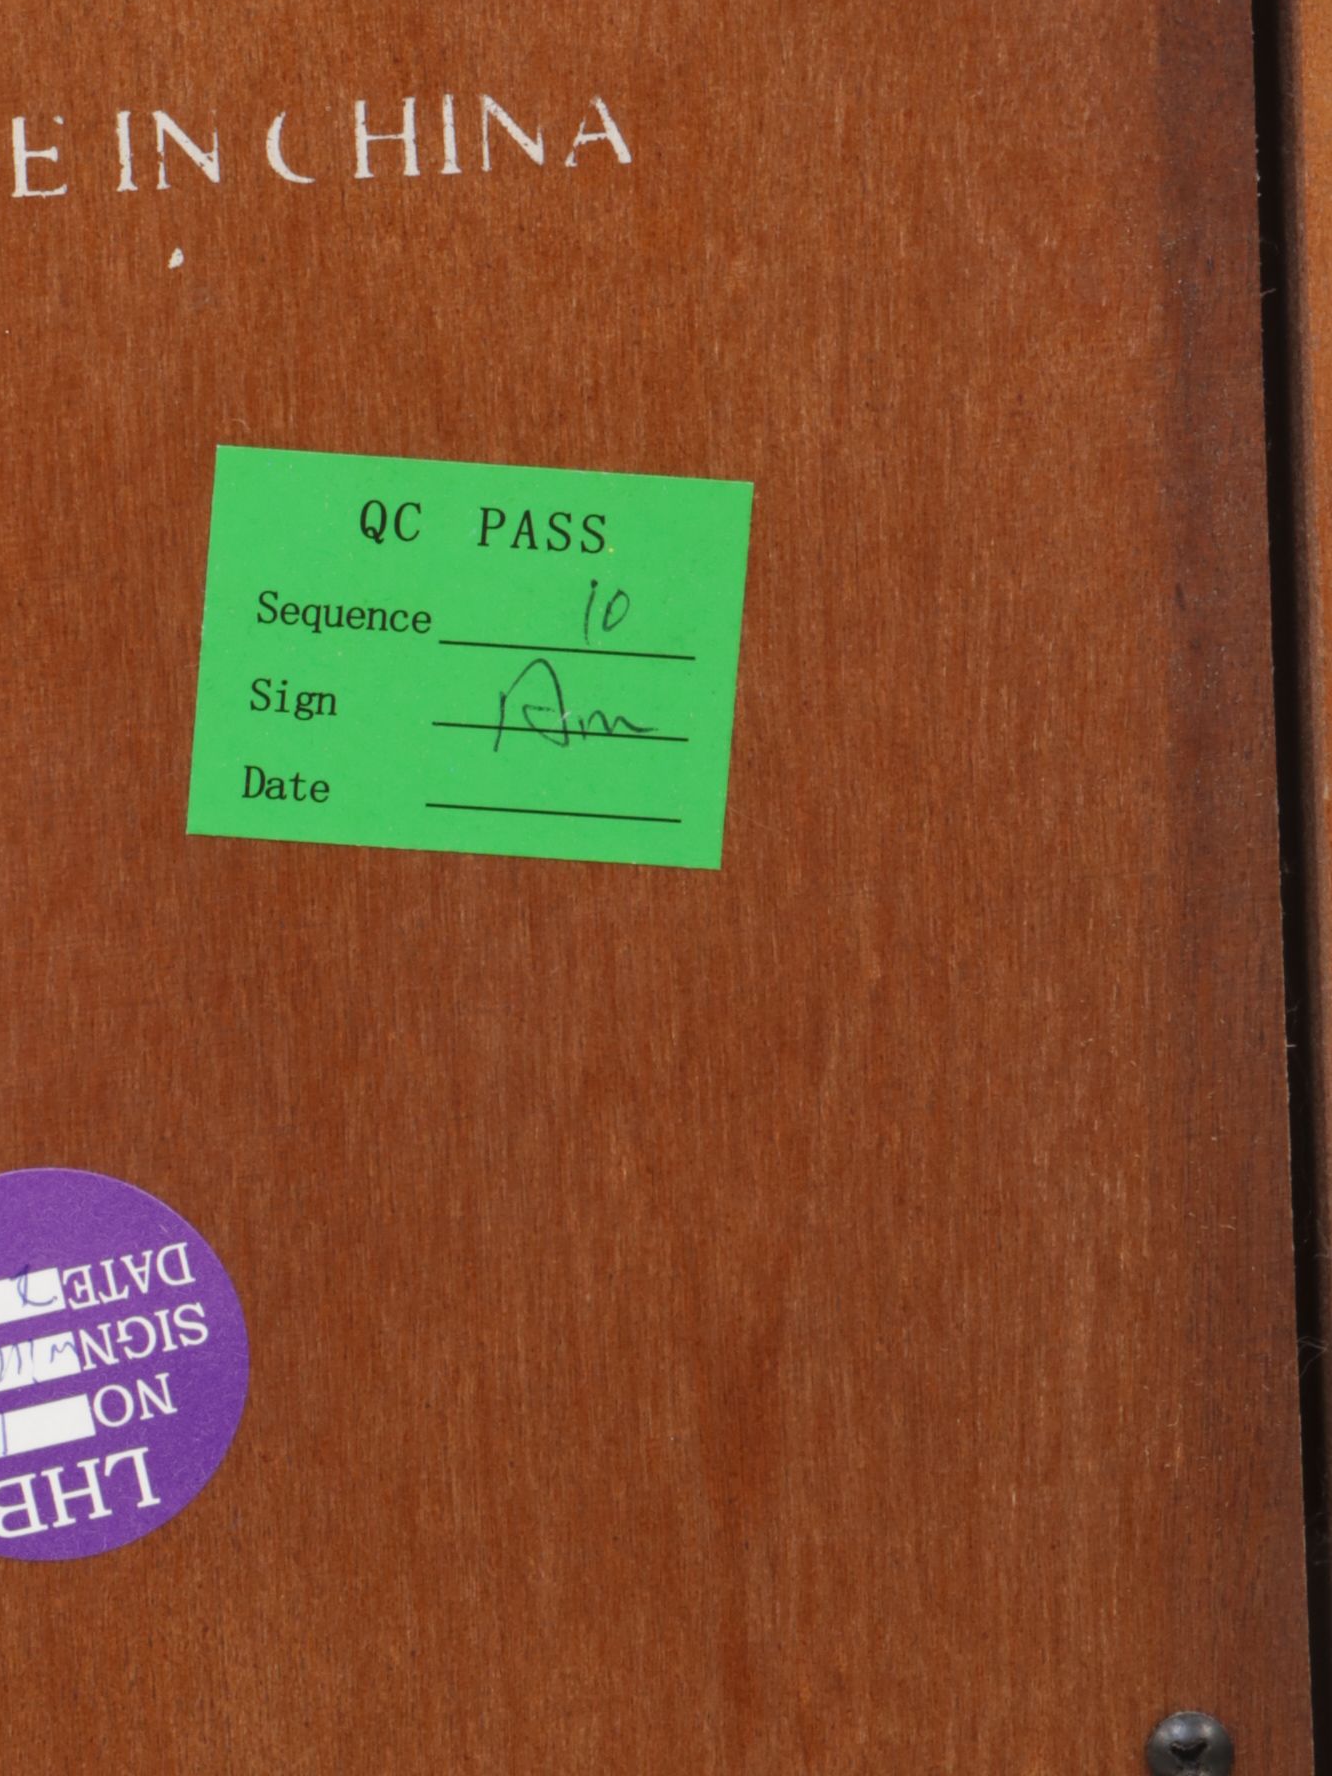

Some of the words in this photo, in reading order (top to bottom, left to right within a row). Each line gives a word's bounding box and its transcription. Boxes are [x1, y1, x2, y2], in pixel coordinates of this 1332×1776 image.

[115, 109, 221, 192] IN
[265, 93, 632, 184] CHINA
[359, 499, 422, 545] QC
[477, 507, 606, 554] PASS
[257, 590, 432, 634] Sequence
[250, 678, 337, 721] Sign
[242, 765, 330, 803] Date
[62, 1241, 196, 1310] DATE
[80, 1302, 209, 1370] SIGN
[92, 1372, 178, 1428] NO
